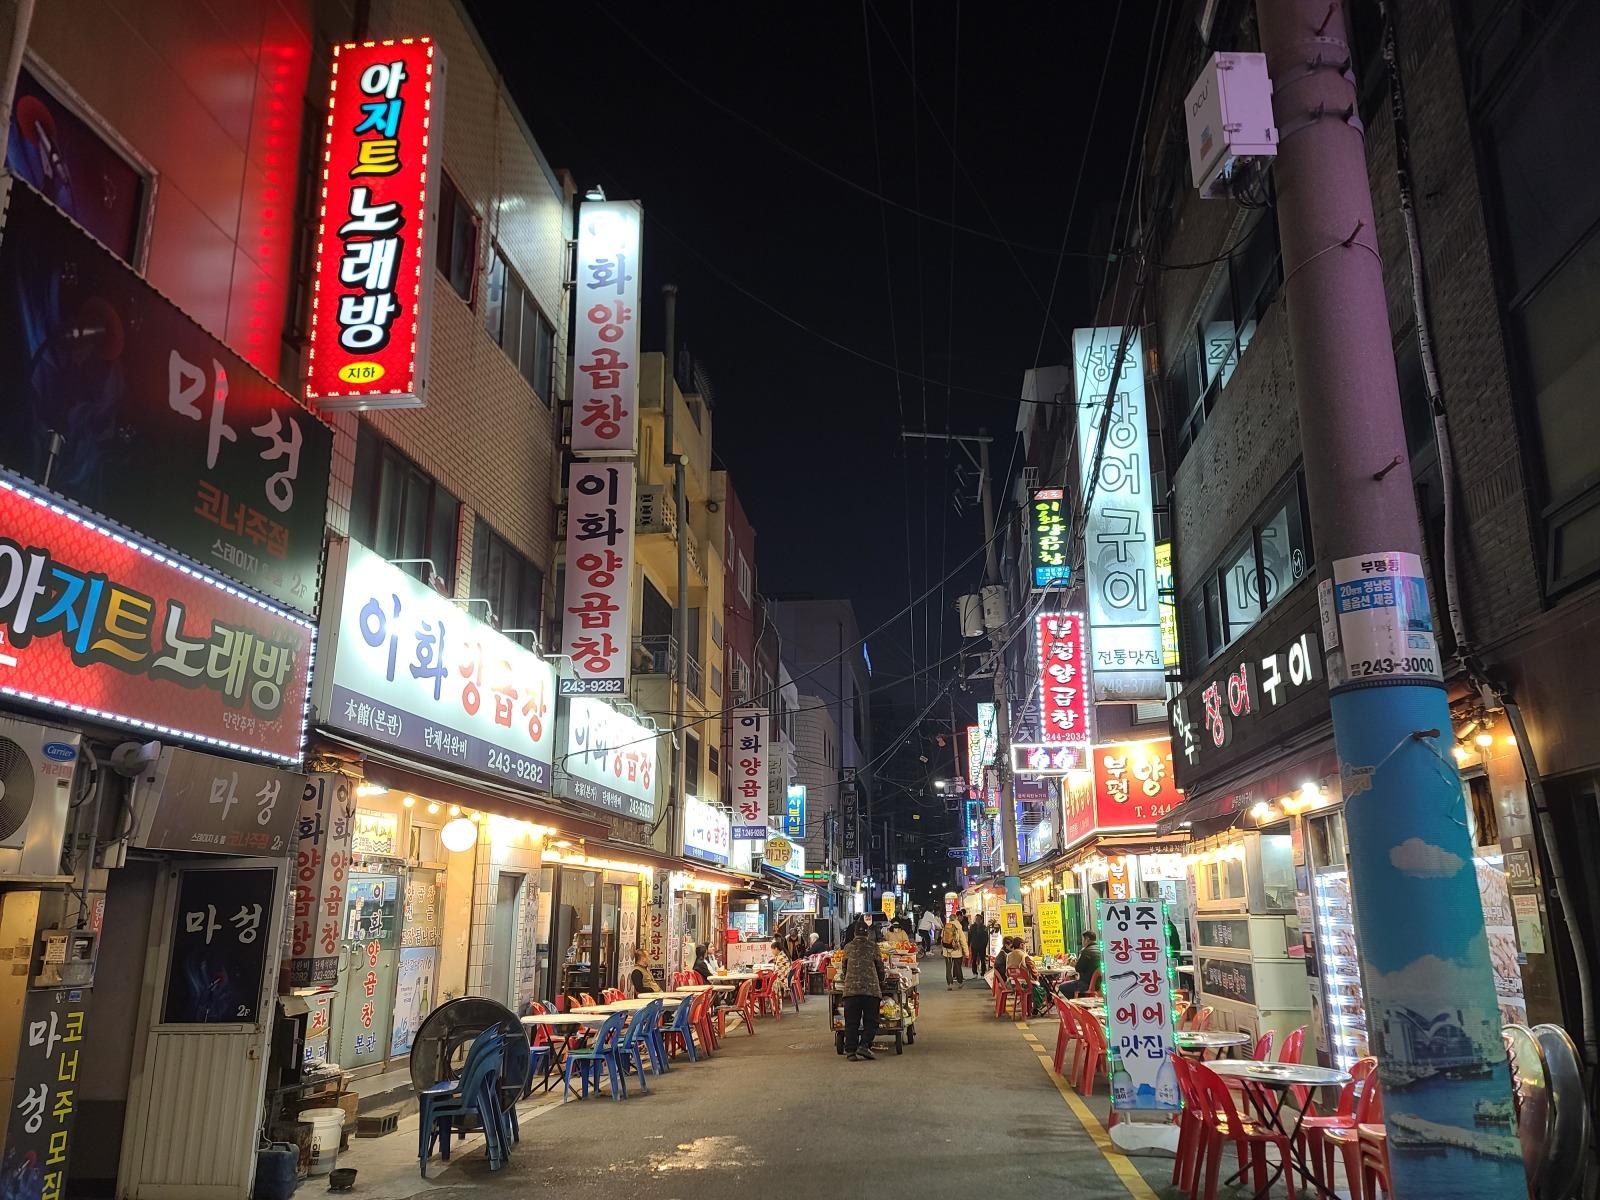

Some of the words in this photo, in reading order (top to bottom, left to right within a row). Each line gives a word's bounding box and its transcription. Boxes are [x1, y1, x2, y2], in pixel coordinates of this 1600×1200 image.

[352, 60, 406, 178] 아지트
[337, 186, 404, 353] 노래방
[346, 366, 376, 380] 지하
[194, 479, 290, 561] 코너주점
[567, 467, 624, 673] 이화양곱창
[1361, 559, 1399, 574] 부평동
[0, 543, 151, 664] 아지트
[152, 604, 293, 711] 노래방
[1097, 648, 1160, 665] 전통맛집
[1361, 657, 1434, 676] 243-3000
[562, 679, 622, 693] 243-9282
[1046, 732, 1087, 742] 244-2034
[47, 745, 73, 758] Carrier
[424, 727, 469, 760] 단체석완비
[487, 749, 544, 785] 243-9282
[738, 713, 762, 821] 이화양곱창
[1103, 754, 1130, 803] 부평
[209, 771, 282, 827] 마성
[1509, 862, 1531, 879] 30-1
[185, 903, 263, 945] 마성
[1106, 905, 1158, 932] 성주
[237, 1004, 251, 1017] 2F
[353, 1031, 377, 1055] 본관
[1120, 1034, 1164, 1059] 맛집
[17, 1010, 62, 1133] 마성
